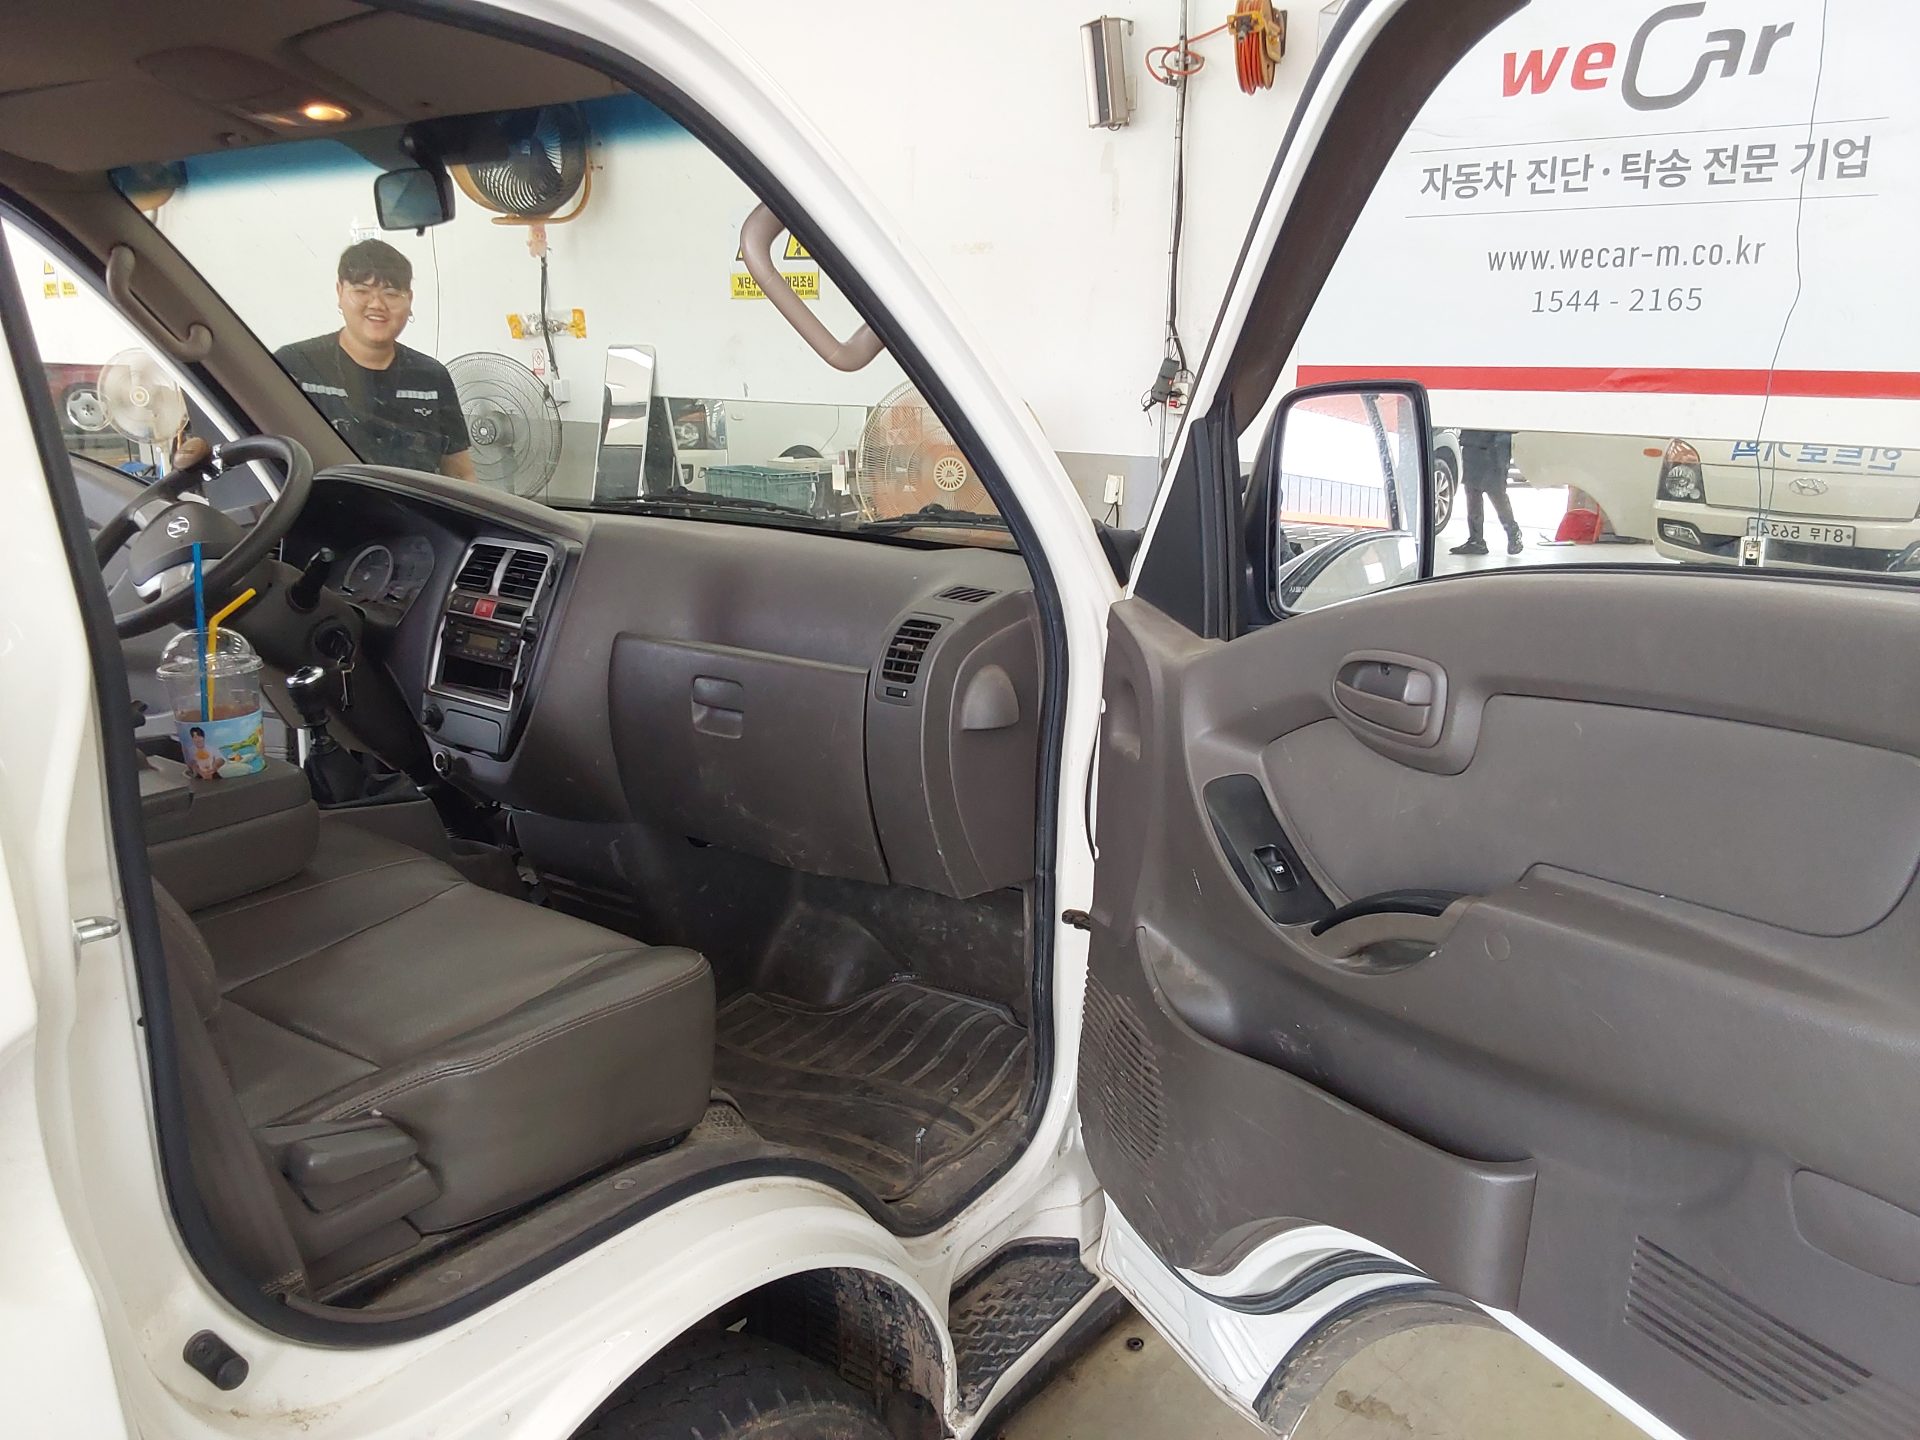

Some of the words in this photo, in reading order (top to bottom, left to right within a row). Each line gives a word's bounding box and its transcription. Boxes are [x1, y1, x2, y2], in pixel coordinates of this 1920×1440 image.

[1502, 2, 1795, 111] weCar
[1420, 156, 1517, 201] 자동차
[1703, 143, 1779, 186] 전문
[1791, 136, 1872, 181] 기업
[1487, 234, 1766, 272] www.wecar-m.co.kr
